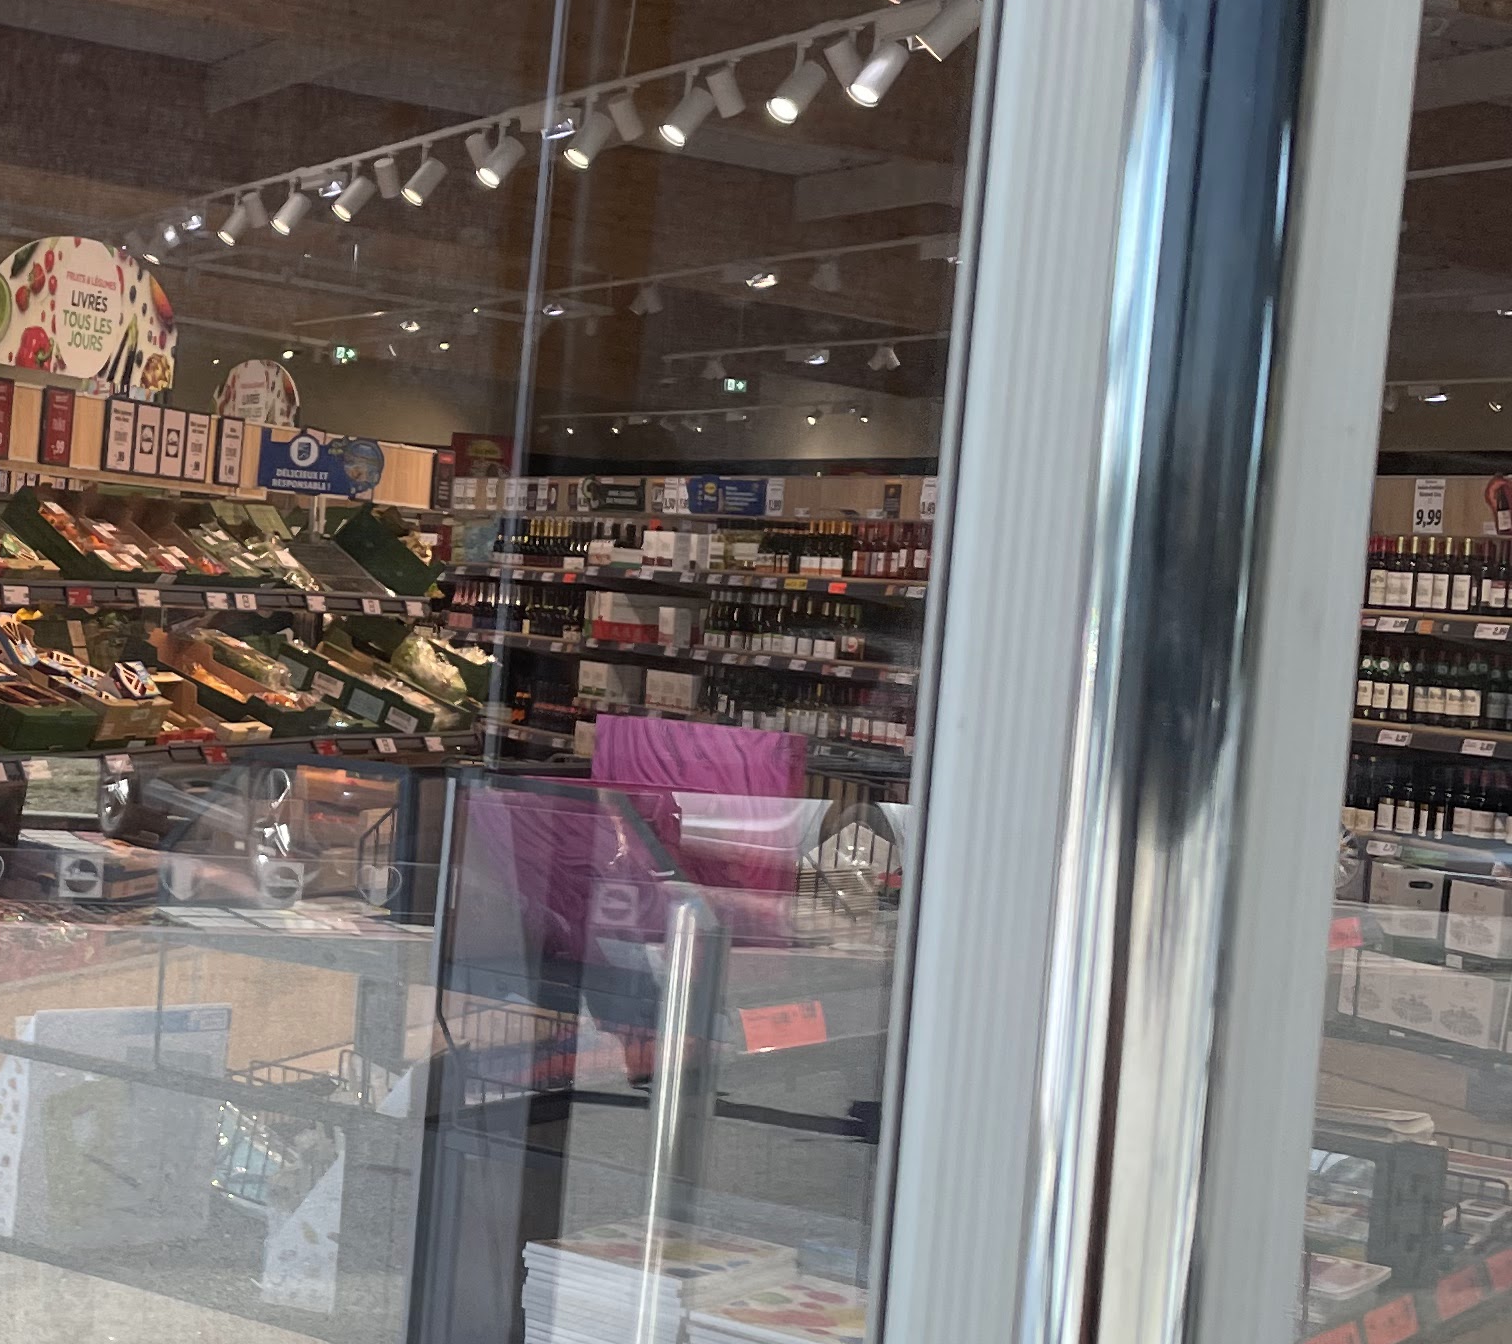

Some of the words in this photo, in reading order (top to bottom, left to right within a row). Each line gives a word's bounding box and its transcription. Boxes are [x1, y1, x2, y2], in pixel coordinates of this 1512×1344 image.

[71, 289, 108, 313] LIVRÉS
[63, 309, 91, 331] TOUS
[93, 316, 112, 335] LES
[67, 330, 103, 352] JOURS
[1415, 509, 1442, 528] 9,99
